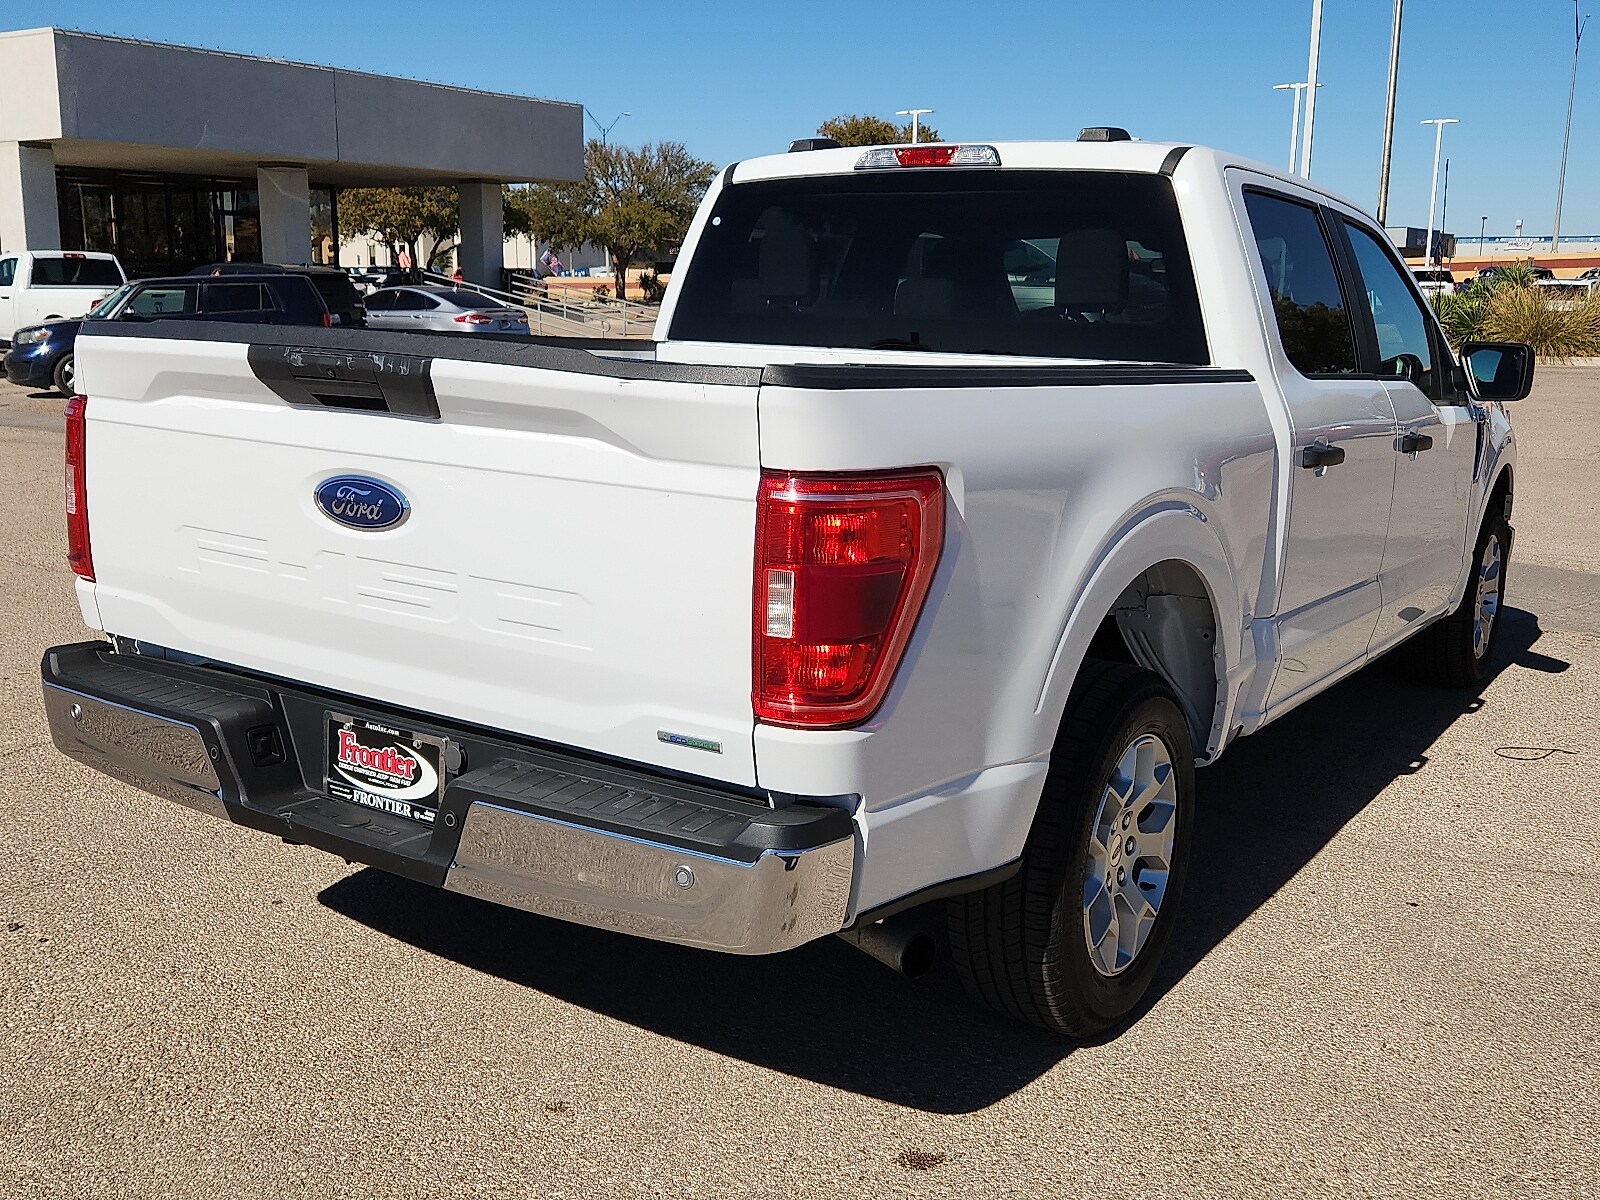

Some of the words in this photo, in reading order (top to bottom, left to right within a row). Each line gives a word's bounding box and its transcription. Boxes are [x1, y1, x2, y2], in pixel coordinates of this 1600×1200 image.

[332, 486, 384, 520] Ford
[176, 524, 593, 652] F-150
[338, 730, 416, 779] Frontier
[353, 790, 412, 817] FRONTIER
